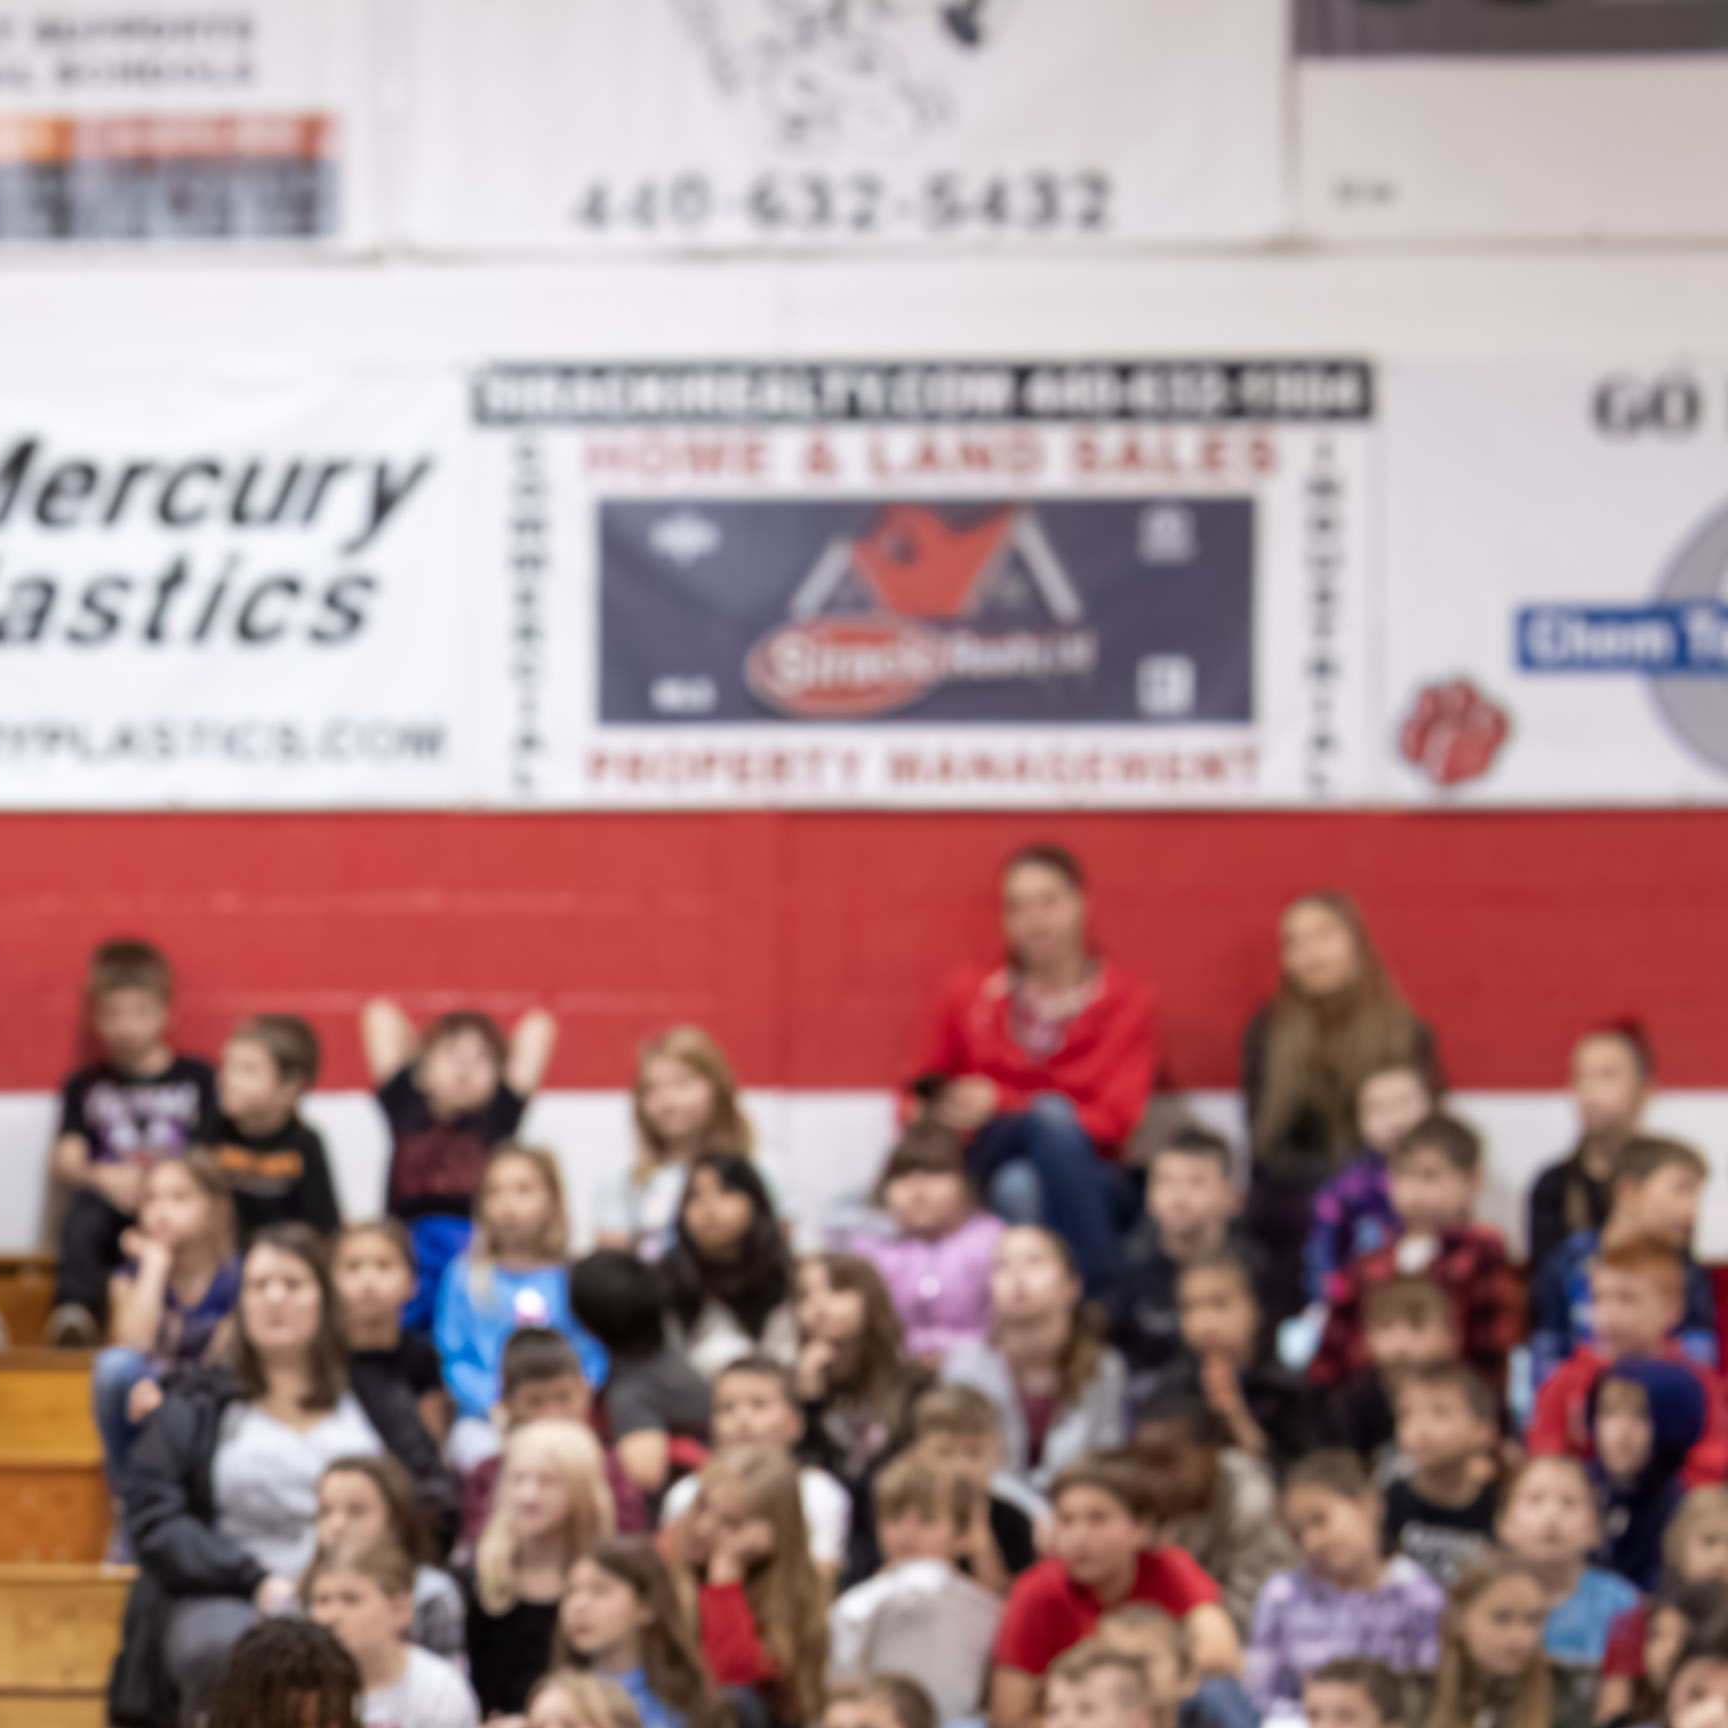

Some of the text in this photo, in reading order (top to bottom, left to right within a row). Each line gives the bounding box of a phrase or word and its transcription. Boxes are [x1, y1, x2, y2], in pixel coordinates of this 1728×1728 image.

[573, 172, 1116, 232] 440-632-5432
[583, 433, 771, 480] HOME
[868, 431, 1045, 478] LAND
[1074, 429, 1283, 480] SALES
[585, 745, 1264, 793] PROPERTY MANAGEMENT
